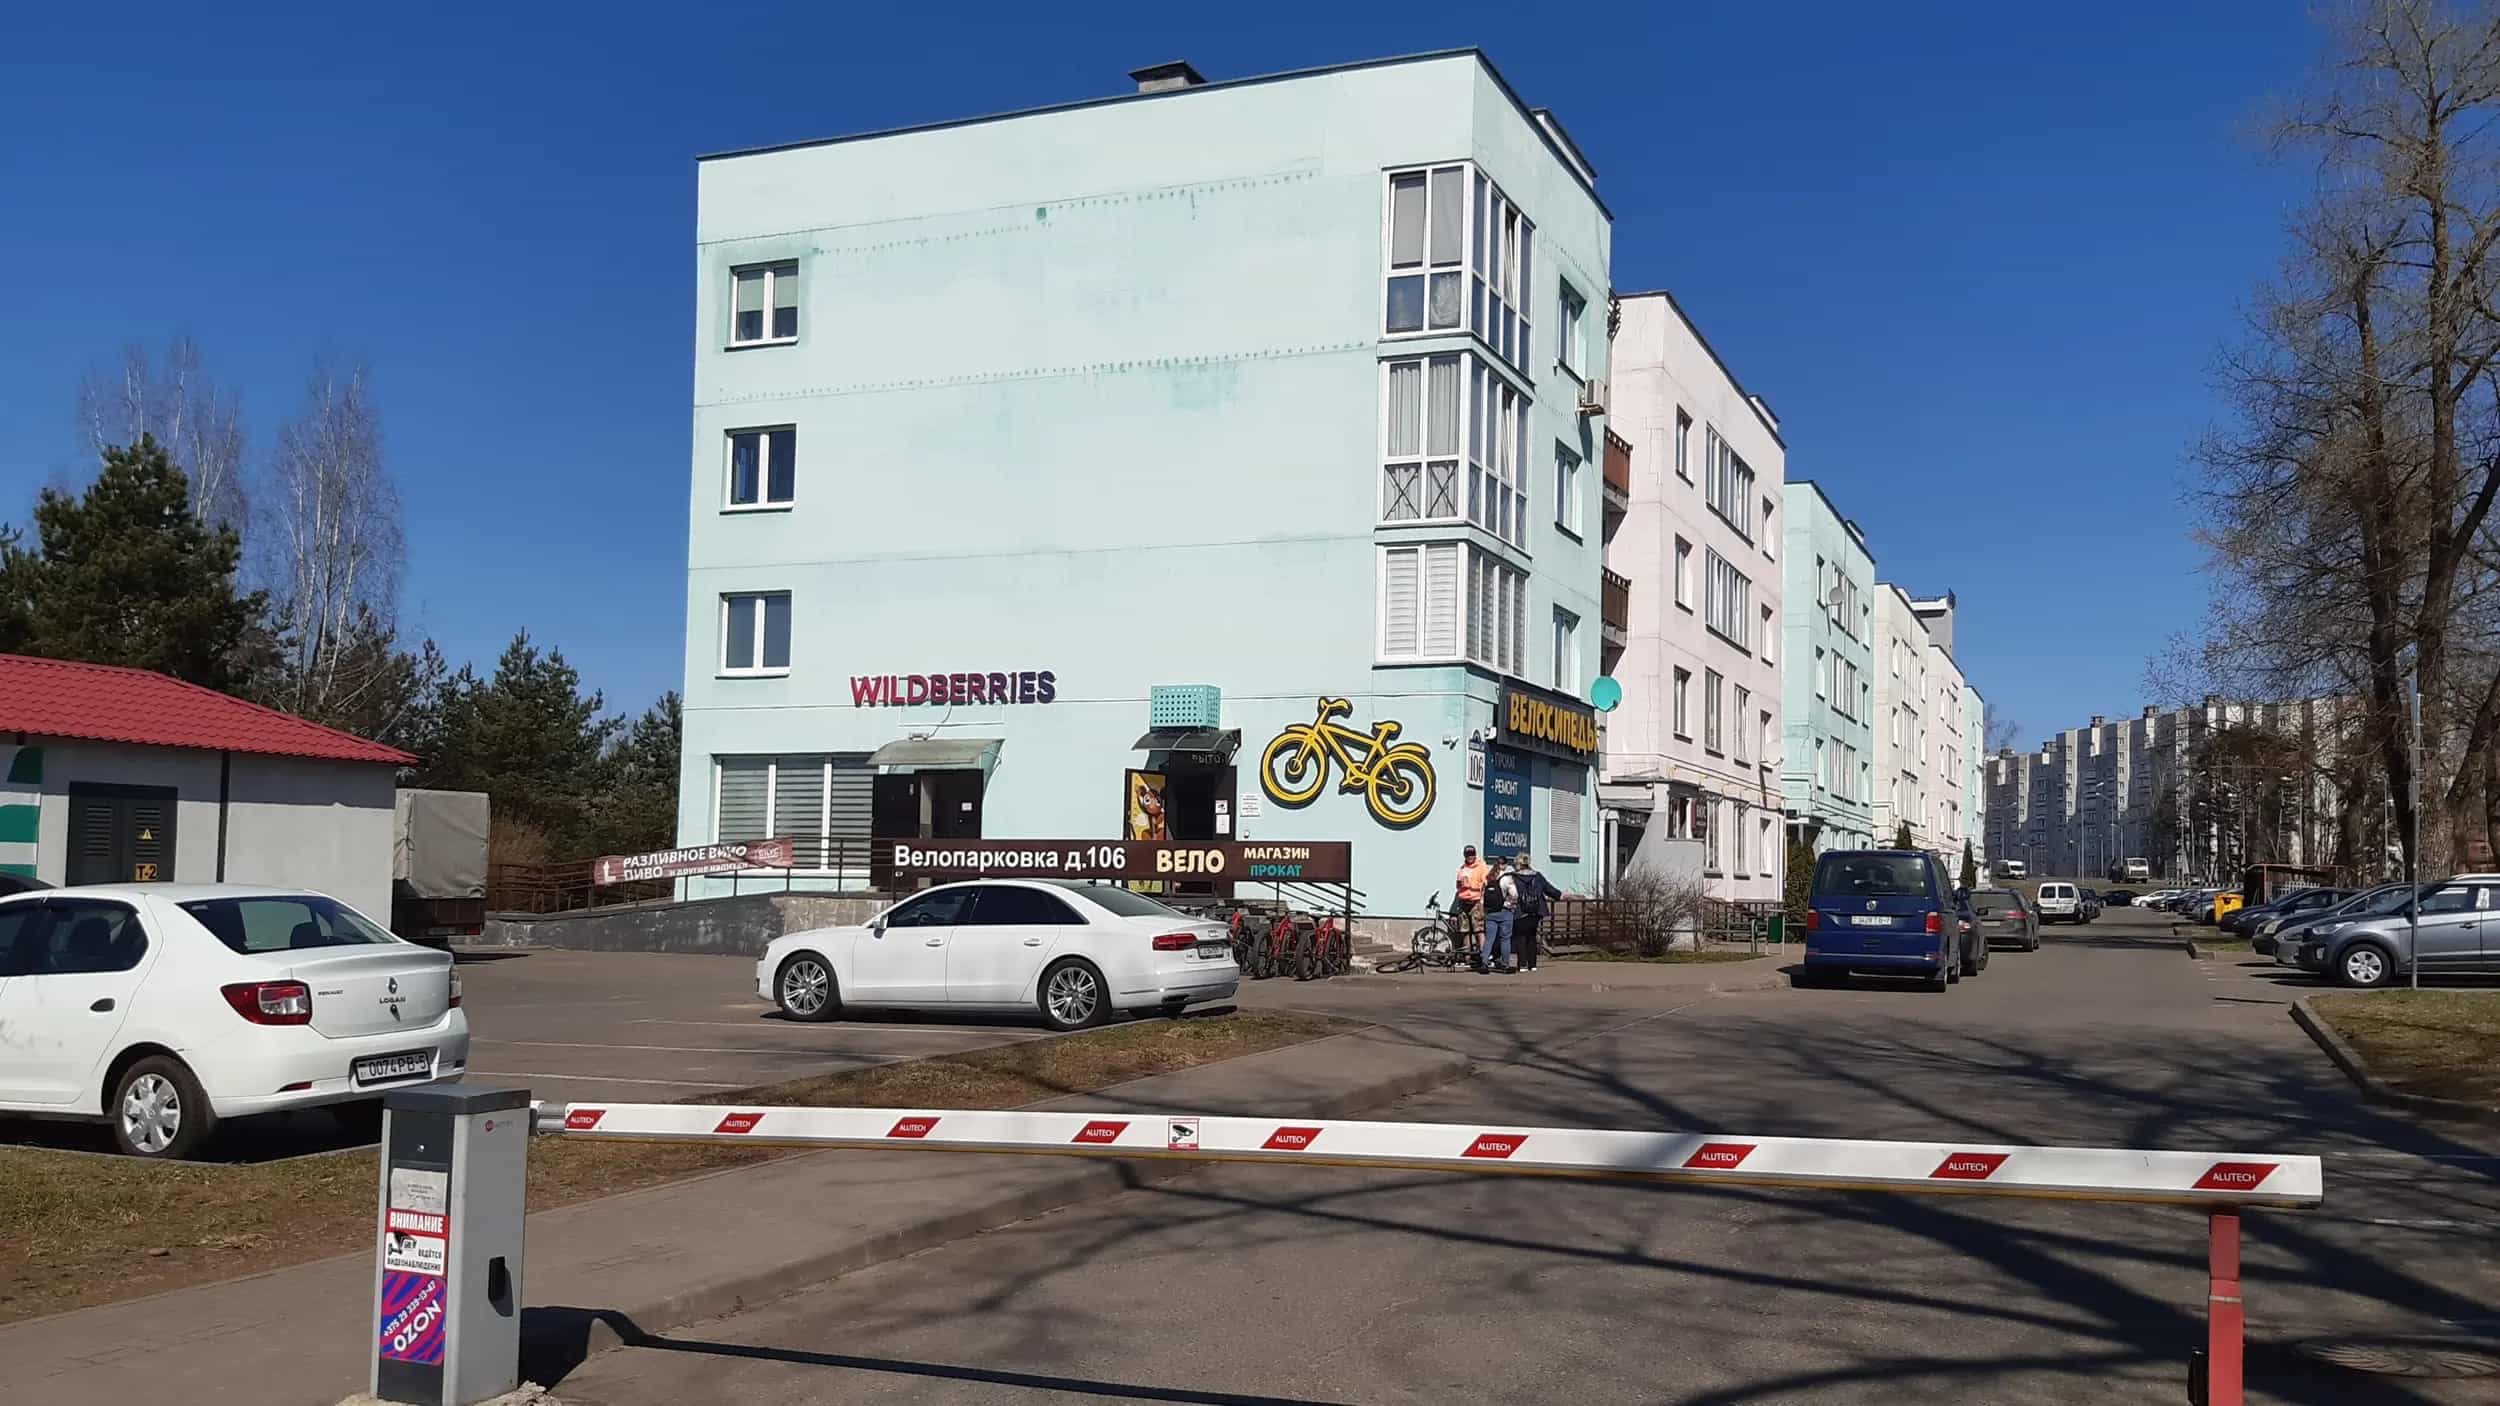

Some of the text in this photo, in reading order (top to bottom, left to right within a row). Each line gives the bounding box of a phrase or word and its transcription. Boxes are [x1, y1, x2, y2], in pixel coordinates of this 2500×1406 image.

[850, 671, 1057, 708] WILDBERRIES
[1509, 692, 1600, 755] ВЕЛОСИПЕДЫ
[1470, 755, 1483, 783] 106
[1494, 778, 1518, 796] РЕМОНТ
[1494, 804, 1523, 821] ЗАПЧАСТИ
[623, 845, 747, 868] РАЗЛИВНОЕ ВИНО
[894, 845, 1127, 872] Велопарковка д.106
[1243, 847, 1311, 860] МАГАЗИН
[1156, 849, 1226, 874] ВЕЛО
[624, 866, 664, 882] ПИВО
[1249, 864, 1304, 878] ПРОКАТ
[379, 996, 406, 1004] LOGAN
[725, 1120, 751, 1128] ALUTECH
[899, 1124, 927, 1132] ALUTECH
[1086, 1128, 1115, 1138] ALUTECH
[1275, 1134, 1306, 1144] ALUTECH
[1477, 1141, 1511, 1151] ALUTECH
[1701, 1152, 1738, 1162] ALUTECH
[1948, 1161, 1988, 1172] ALUTECH
[2212, 1172, 2256, 1183] ALUTECH
[389, 1211, 444, 1233] ВНИМАНИЕ
[393, 1299, 442, 1352] OZON
